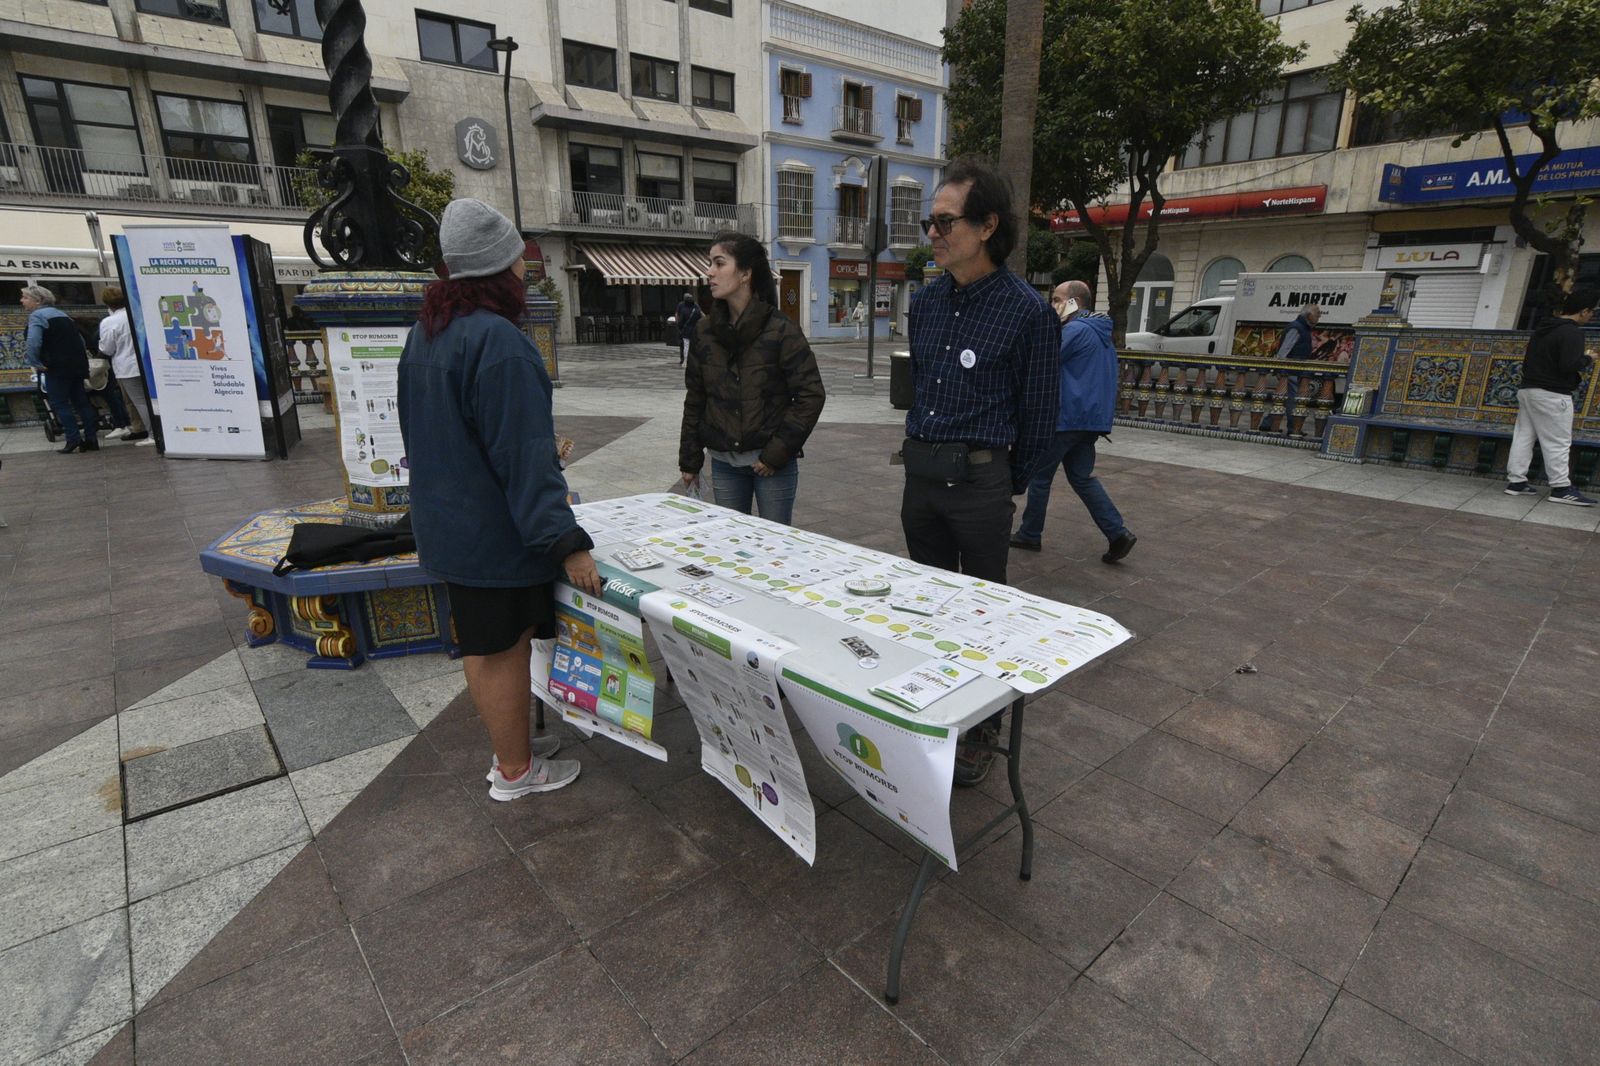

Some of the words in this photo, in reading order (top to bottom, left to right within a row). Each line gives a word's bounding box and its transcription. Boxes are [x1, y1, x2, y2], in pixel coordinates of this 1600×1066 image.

[1551, 161, 1584, 171] MUTUA
[1271, 197, 1316, 206] NorteHispana
[1395, 250, 1460, 263] LULA
[22, 260, 80, 270] ESKINA
[278, 269, 300, 277] BAR
[586, 601, 598, 611] STOP
[597, 606, 620, 622] RUMORES
[689, 608, 708, 619] STOP
[706, 615, 742, 633] RUMORES
[833, 748, 853, 766] STOP
[854, 762, 899, 794] RUMORES
